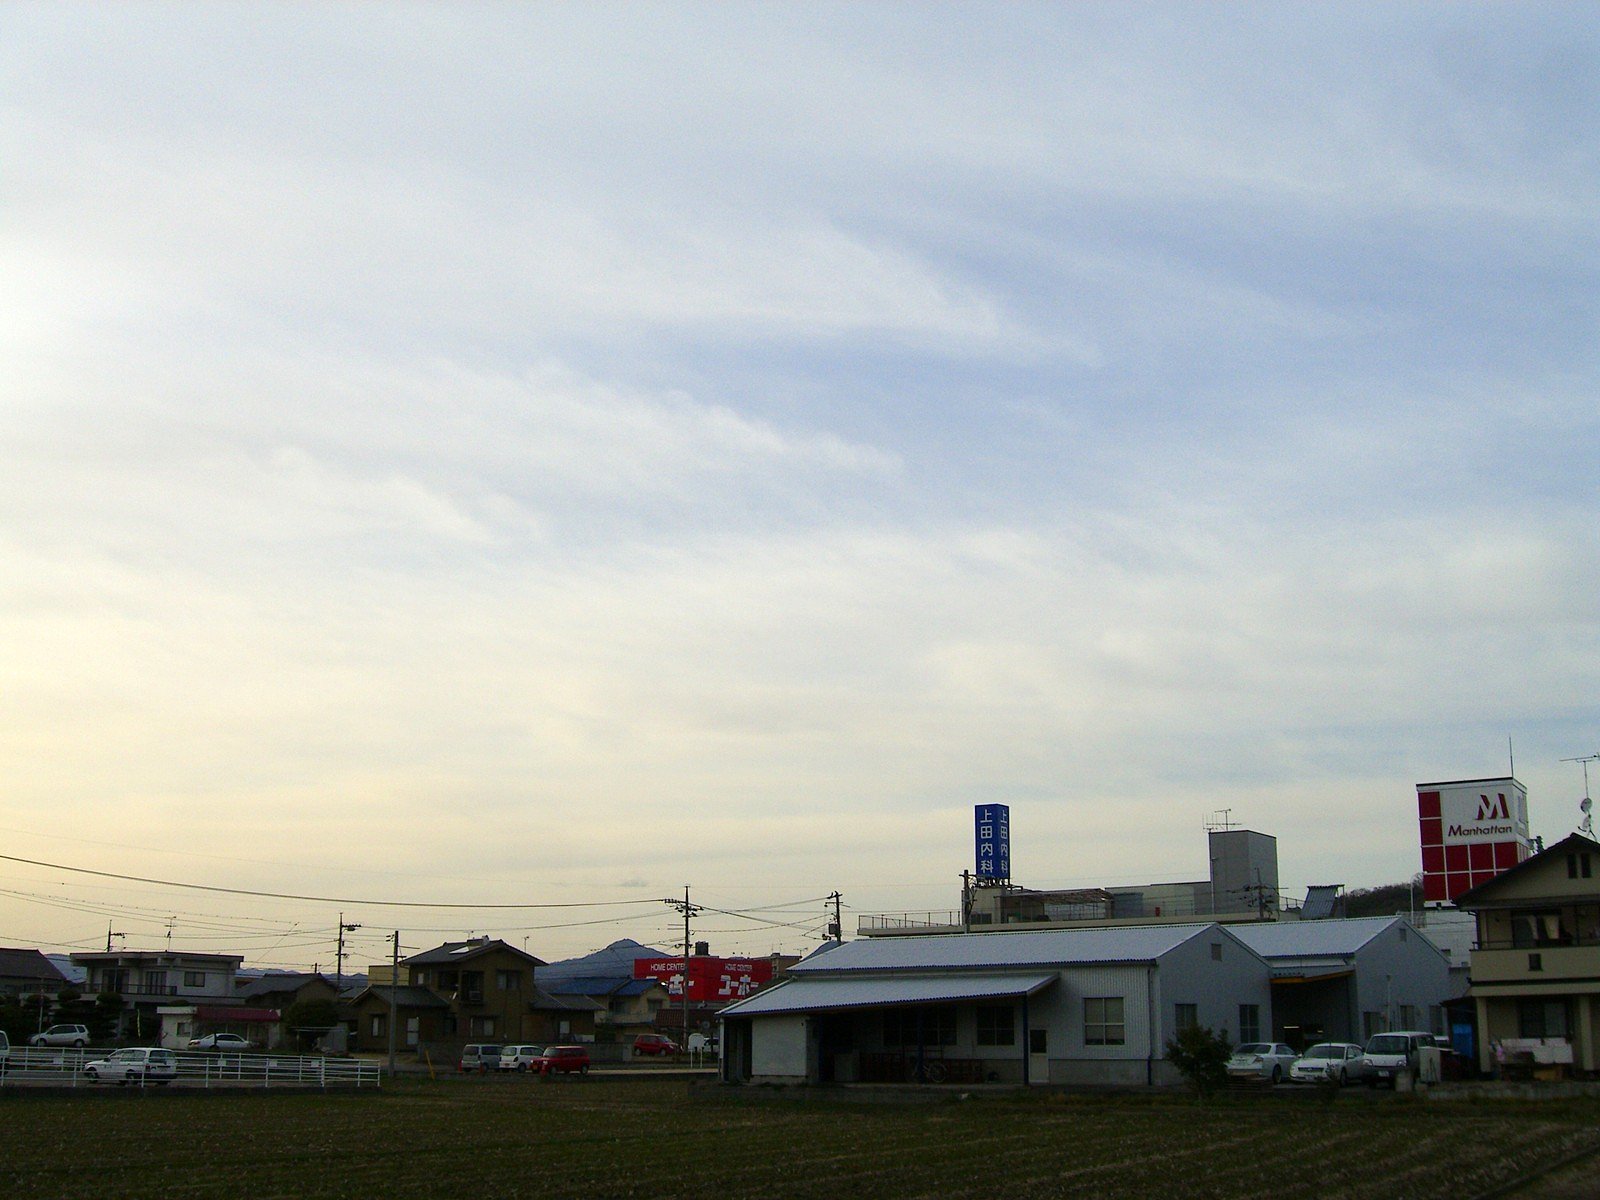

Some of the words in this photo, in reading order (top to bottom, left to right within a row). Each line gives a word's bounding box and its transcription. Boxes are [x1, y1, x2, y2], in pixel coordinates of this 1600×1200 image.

[980, 808, 993, 874] 上田内科
[1000, 809, 1008, 874] 上田内科
[1448, 825, 1512, 837] Manhattan
[650, 963, 666, 971] HOME
[666, 963, 686, 971] CENTE
